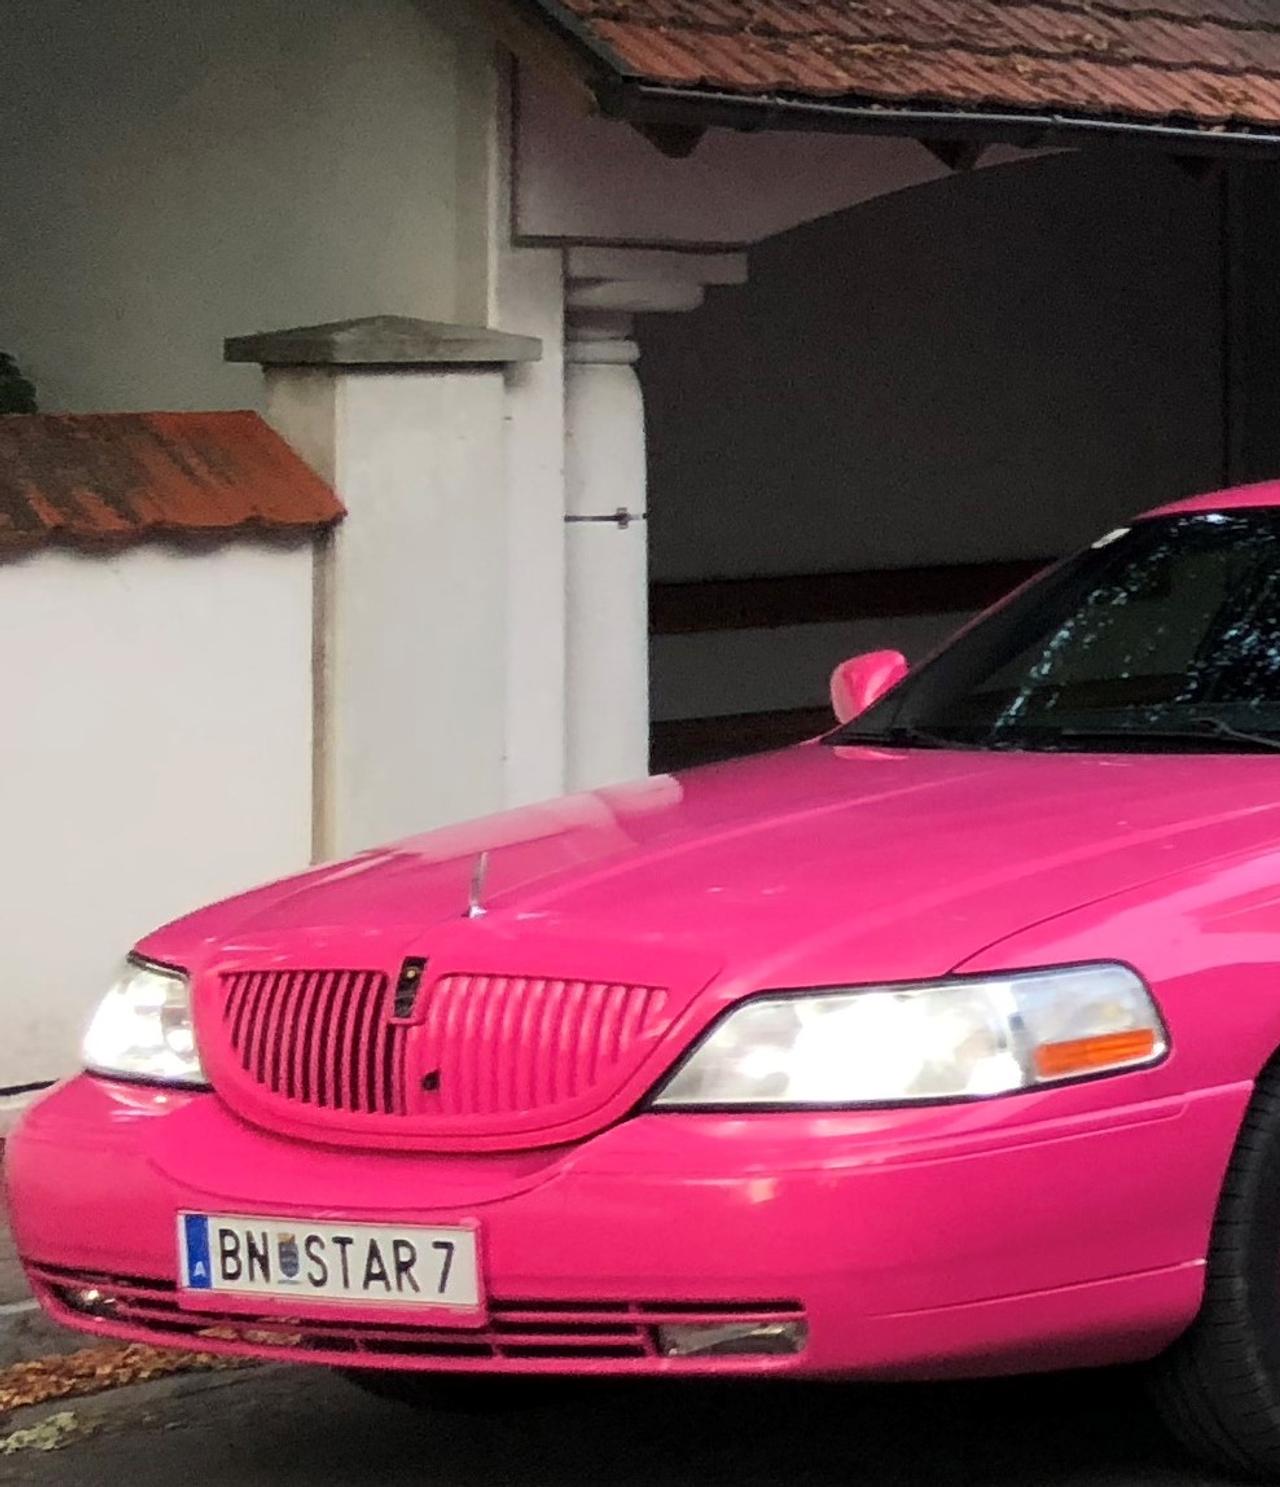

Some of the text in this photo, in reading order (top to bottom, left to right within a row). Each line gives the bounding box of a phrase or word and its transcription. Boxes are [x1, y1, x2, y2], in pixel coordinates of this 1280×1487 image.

[193, 1261, 206, 1278] A
[218, 1228, 455, 1294] BN STAR 7
